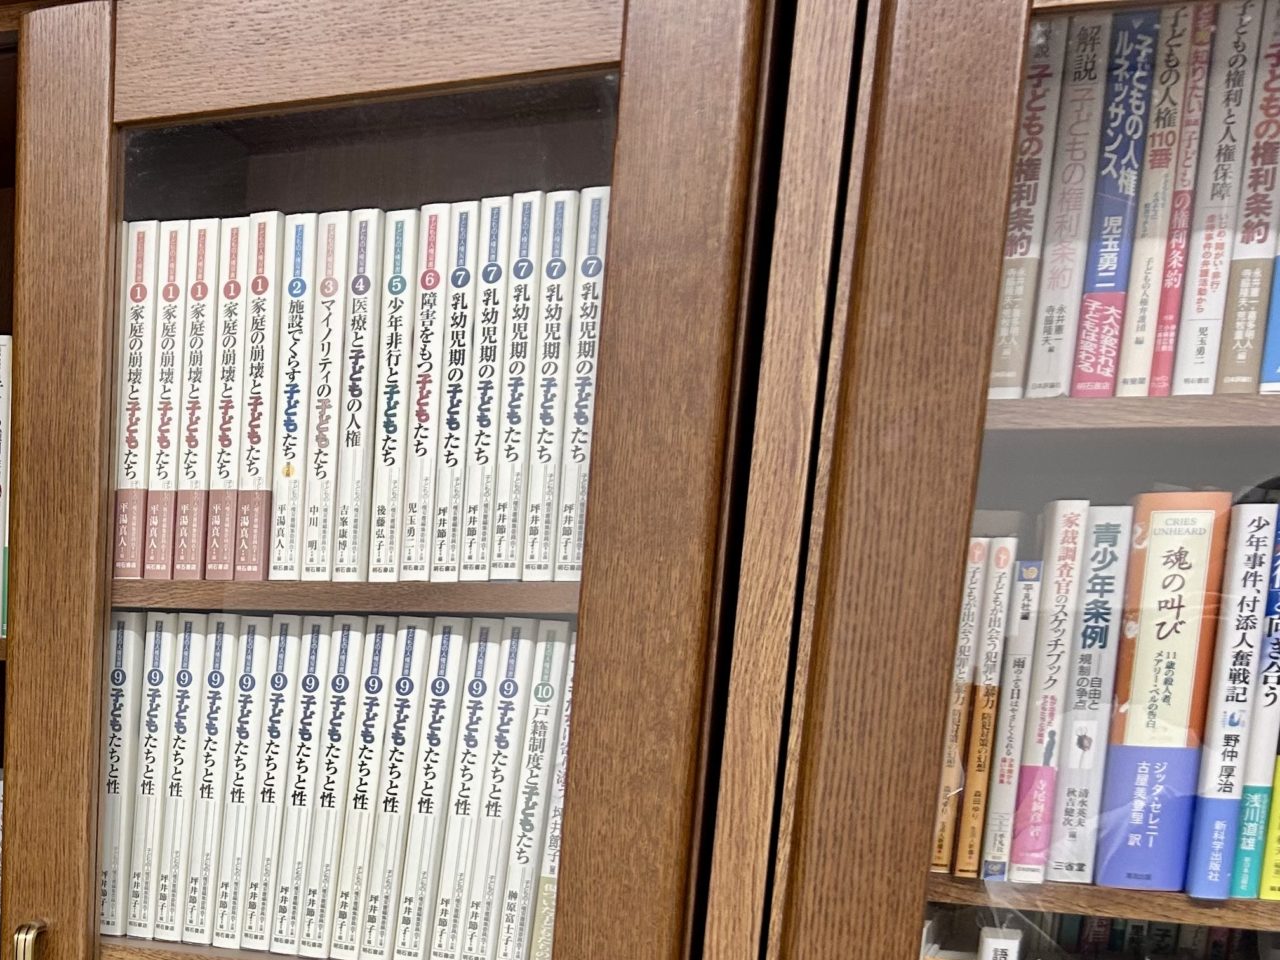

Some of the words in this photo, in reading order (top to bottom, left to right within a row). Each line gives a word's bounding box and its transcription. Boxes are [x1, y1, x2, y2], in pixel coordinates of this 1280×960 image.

[1073, 26, 1102, 81] 解説
[1102, 31, 1134, 177] ルネッサンス
[1149, 7, 1189, 169] 子どもの人権110番
[1210, 1, 1254, 200] 子どもの権利と人権保障
[1005, 64, 1053, 257] 子どもの権利条約
[1118, 34, 1153, 196] 子どもの人権
[1096, 216, 1122, 286] 児玉勇二
[123, 304, 146, 479] 家庭の崩壊と子どもたち
[155, 304, 178, 479] 家庭の崩壊と子どもたち
[183, 302, 207, 479] 家庭の崩壊と子どもたち
[216, 301, 239, 479] 家庭の崩壊と子どもたち
[245, 297, 267, 477] 家庭の崩壊と子どもたち
[281, 299, 305, 460] 施設でくらす子どもたち
[313, 299, 337, 479] マイノリティの子どもたち
[345, 297, 369, 448] 医療と子どもの人権
[381, 297, 405, 466] 少年非行と子どもたち
[413, 292, 438, 457] 障害をもつ子どもたち
[443, 293, 468, 467] 乳幼児期の子どもたち
[474, 288, 500, 465] 乳幼児期の子どもたち
[504, 284, 531, 462] 乳幼児期の子どもたち
[536, 284, 564, 463] 乳幼児期の子どもたち
[571, 282, 599, 463] 乳幼児期の子どもたち
[1078, 300, 1103, 373] 子どもは変わる
[1097, 305, 1122, 378] 大人が変われば
[1153, 526, 1207, 537] UNHEARD
[1165, 517, 1197, 526] CRIES
[982, 571, 1007, 708] 子どもが出会う犯罪と暴力
[1043, 512, 1081, 690] 家裁調査官のスケッチブック
[1081, 523, 1122, 649] 青少年条例
[1155, 546, 1193, 641] 魂の叫び
[1225, 516, 1270, 703] 少年事件、付添人奮戦記
[1073, 654, 1092, 711] 規制の争点
[106, 688, 125, 795] 子どもたちと性
[140, 688, 162, 795] 子どもたちと性
[169, 689, 191, 797] 子どもたちと性
[199, 691, 222, 799] 子どもたちと性
[230, 694, 253, 804] 子どもたちと性
[260, 693, 285, 804] 子どもたちと性
[291, 695, 317, 807] 子どもたちと性
[319, 696, 347, 808] 子どもたちと性
[352, 697, 380, 810] 子どもたちと性
[516, 704, 551, 865] 戸籍制度と子どもたち
[1131, 761, 1151, 824] 古屋美登里
[1217, 765, 1237, 793] 厚治
[1221, 734, 1240, 762] 野仲
[1062, 788, 1077, 827] 秋吉健次
[1076, 788, 1090, 827] 清水英夫
[1128, 833, 1141, 846] 訳
[1147, 761, 1168, 848] ジッタ・セレニー
[1208, 820, 1227, 881] 新科学出版社
[1240, 794, 1263, 850] 浅川道雄
[1053, 861, 1086, 872] 三省堂
